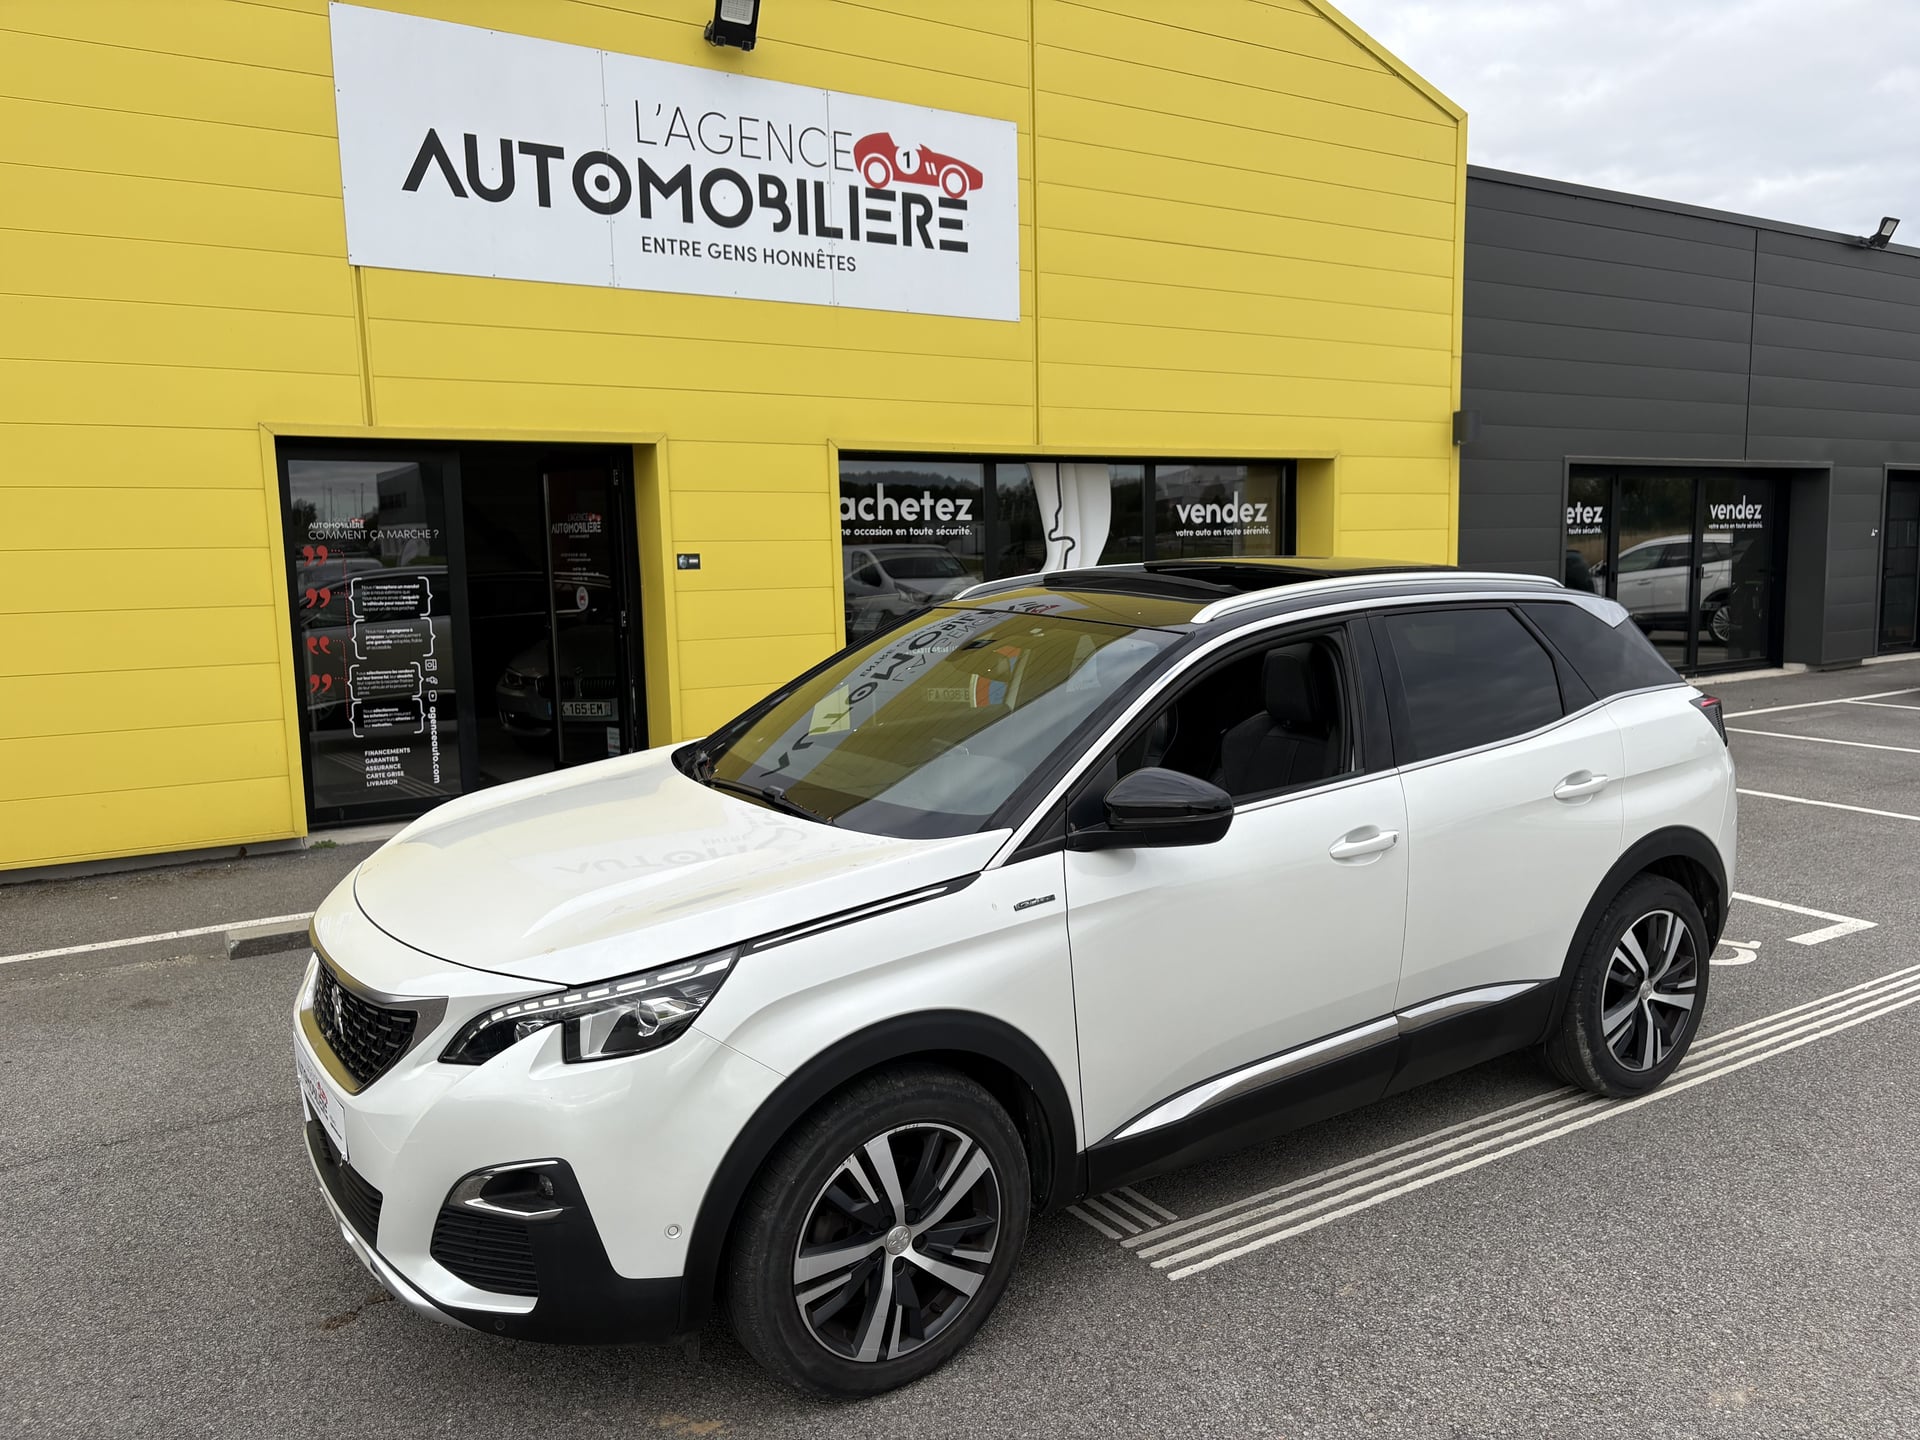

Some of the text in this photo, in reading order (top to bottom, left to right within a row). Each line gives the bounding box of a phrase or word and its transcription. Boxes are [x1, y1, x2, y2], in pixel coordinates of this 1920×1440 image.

[635, 98, 854, 172] L'AGENCE
[902, 150, 911, 169] 1
[641, 235, 857, 273] ENTRE GENS HONNÊTES
[839, 482, 973, 521] achetez
[1175, 490, 1268, 524] vendez
[1709, 494, 1763, 520] vendez
[1566, 501, 1604, 524] etez
[307, 529, 439, 541] COMMENT ÇA MARCHE ?
[853, 525, 893, 536] occasion
[895, 527, 907, 536] en
[909, 526, 934, 536] toute
[935, 524, 973, 536] sécurité.
[1175, 528, 1194, 537] votre
[1195, 528, 1211, 536] auto
[1223, 527, 1242, 536] toute
[364, 747, 411, 756] FINANCEMENTS
[427, 706, 440, 784] agenceauto.com
[365, 755, 399, 764] GARANTIES
[365, 763, 402, 772] ASSURANCE
[366, 779, 398, 788] LIVRAISON
